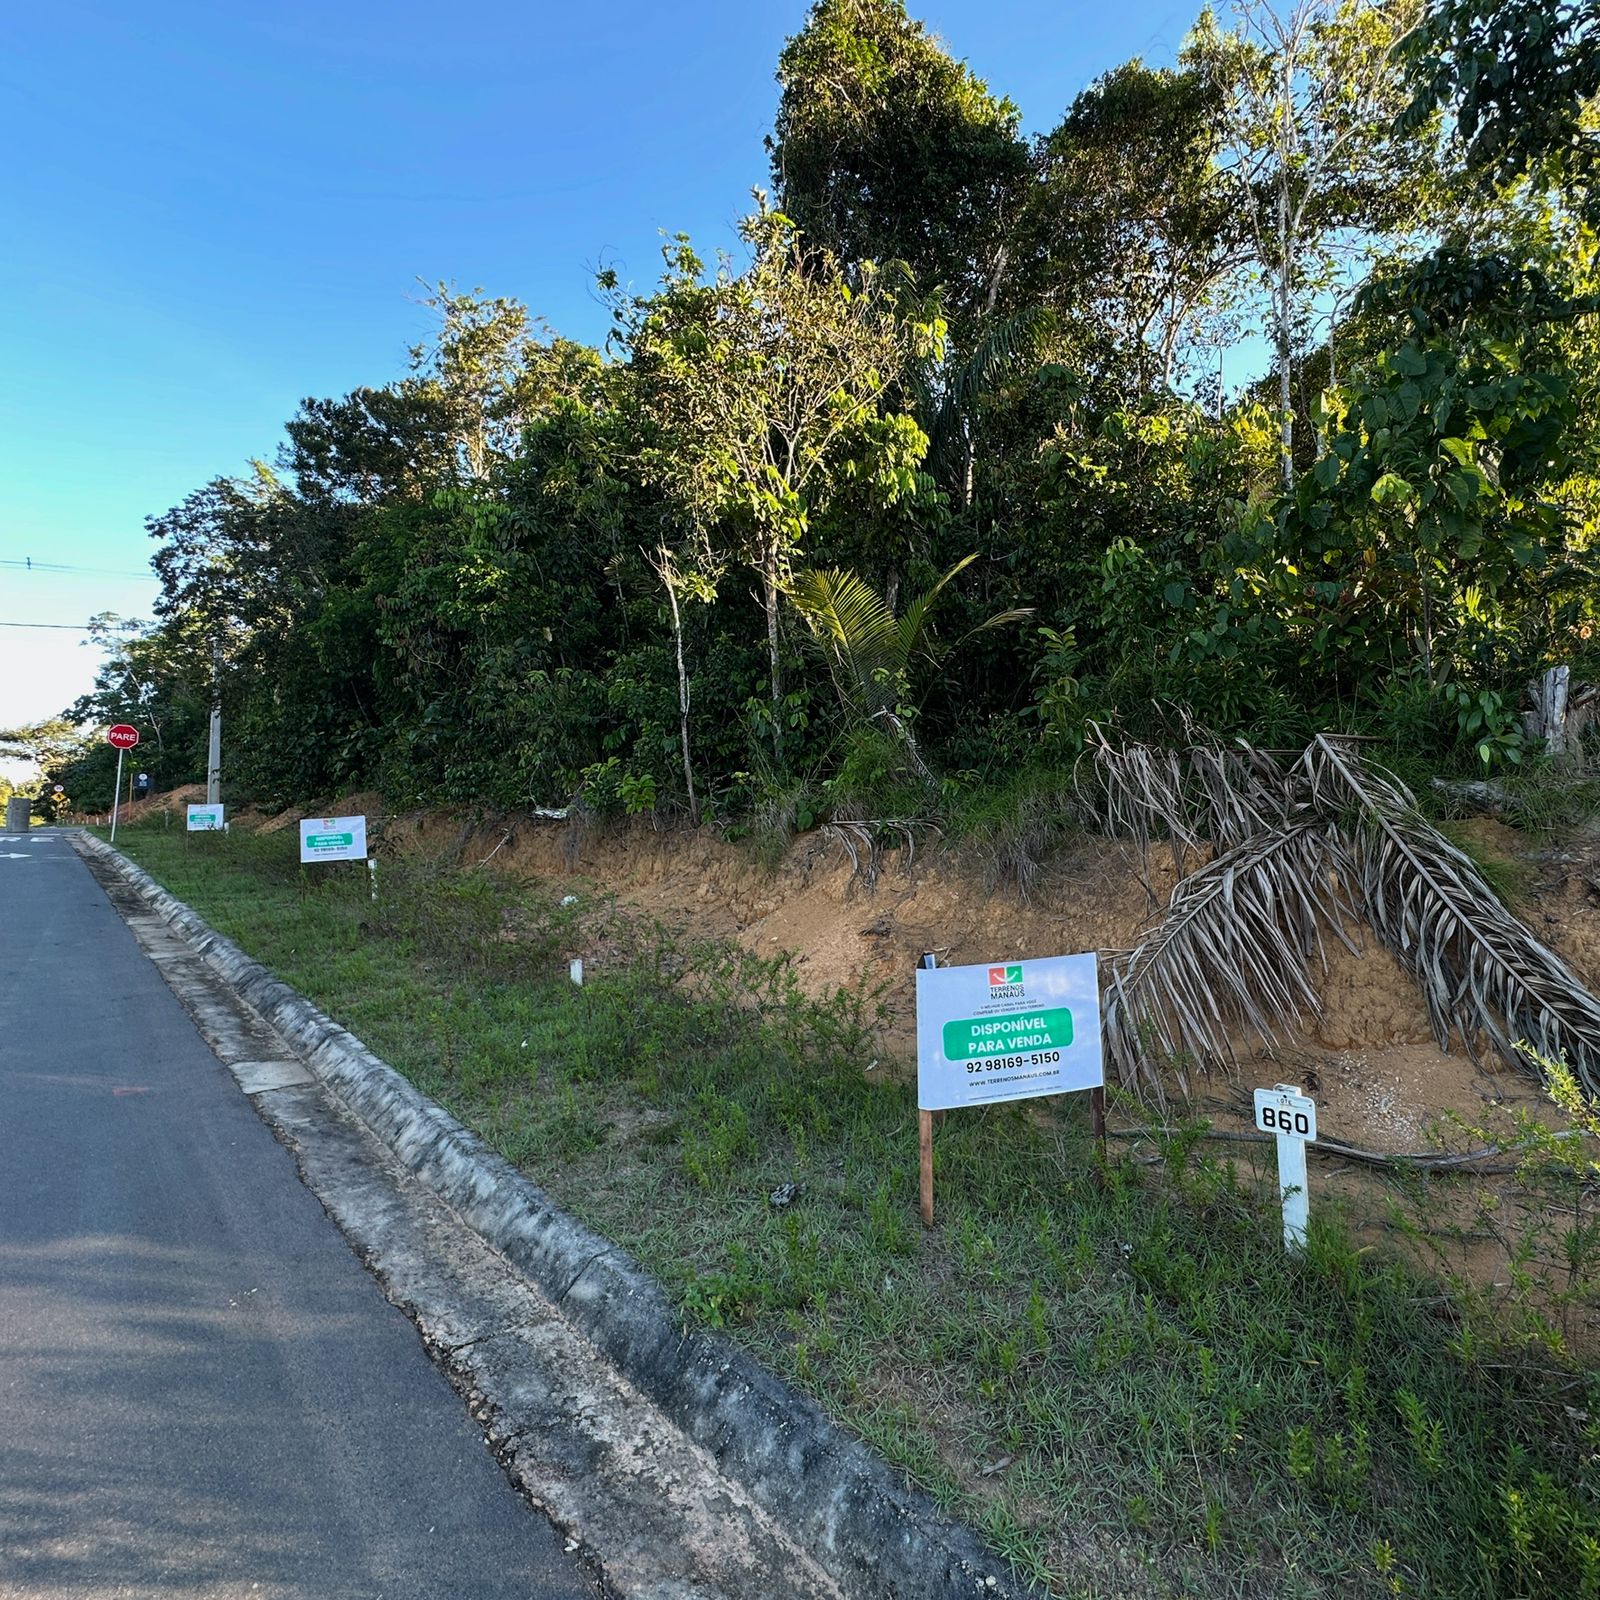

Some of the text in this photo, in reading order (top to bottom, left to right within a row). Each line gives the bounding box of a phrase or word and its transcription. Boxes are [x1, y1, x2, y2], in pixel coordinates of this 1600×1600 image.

[110, 732, 136, 742] PARE
[990, 984, 1024, 993] TERRENOS
[991, 991, 1025, 1000] MANAUS
[971, 1017, 1047, 1037] DISPONÍVEL
[968, 1033, 1052, 1054] PARA VENDA
[966, 1051, 1060, 1073] 92 98169-5150
[1276, 1098, 1293, 1106] LOTE
[1262, 1107, 1309, 1134] 860
